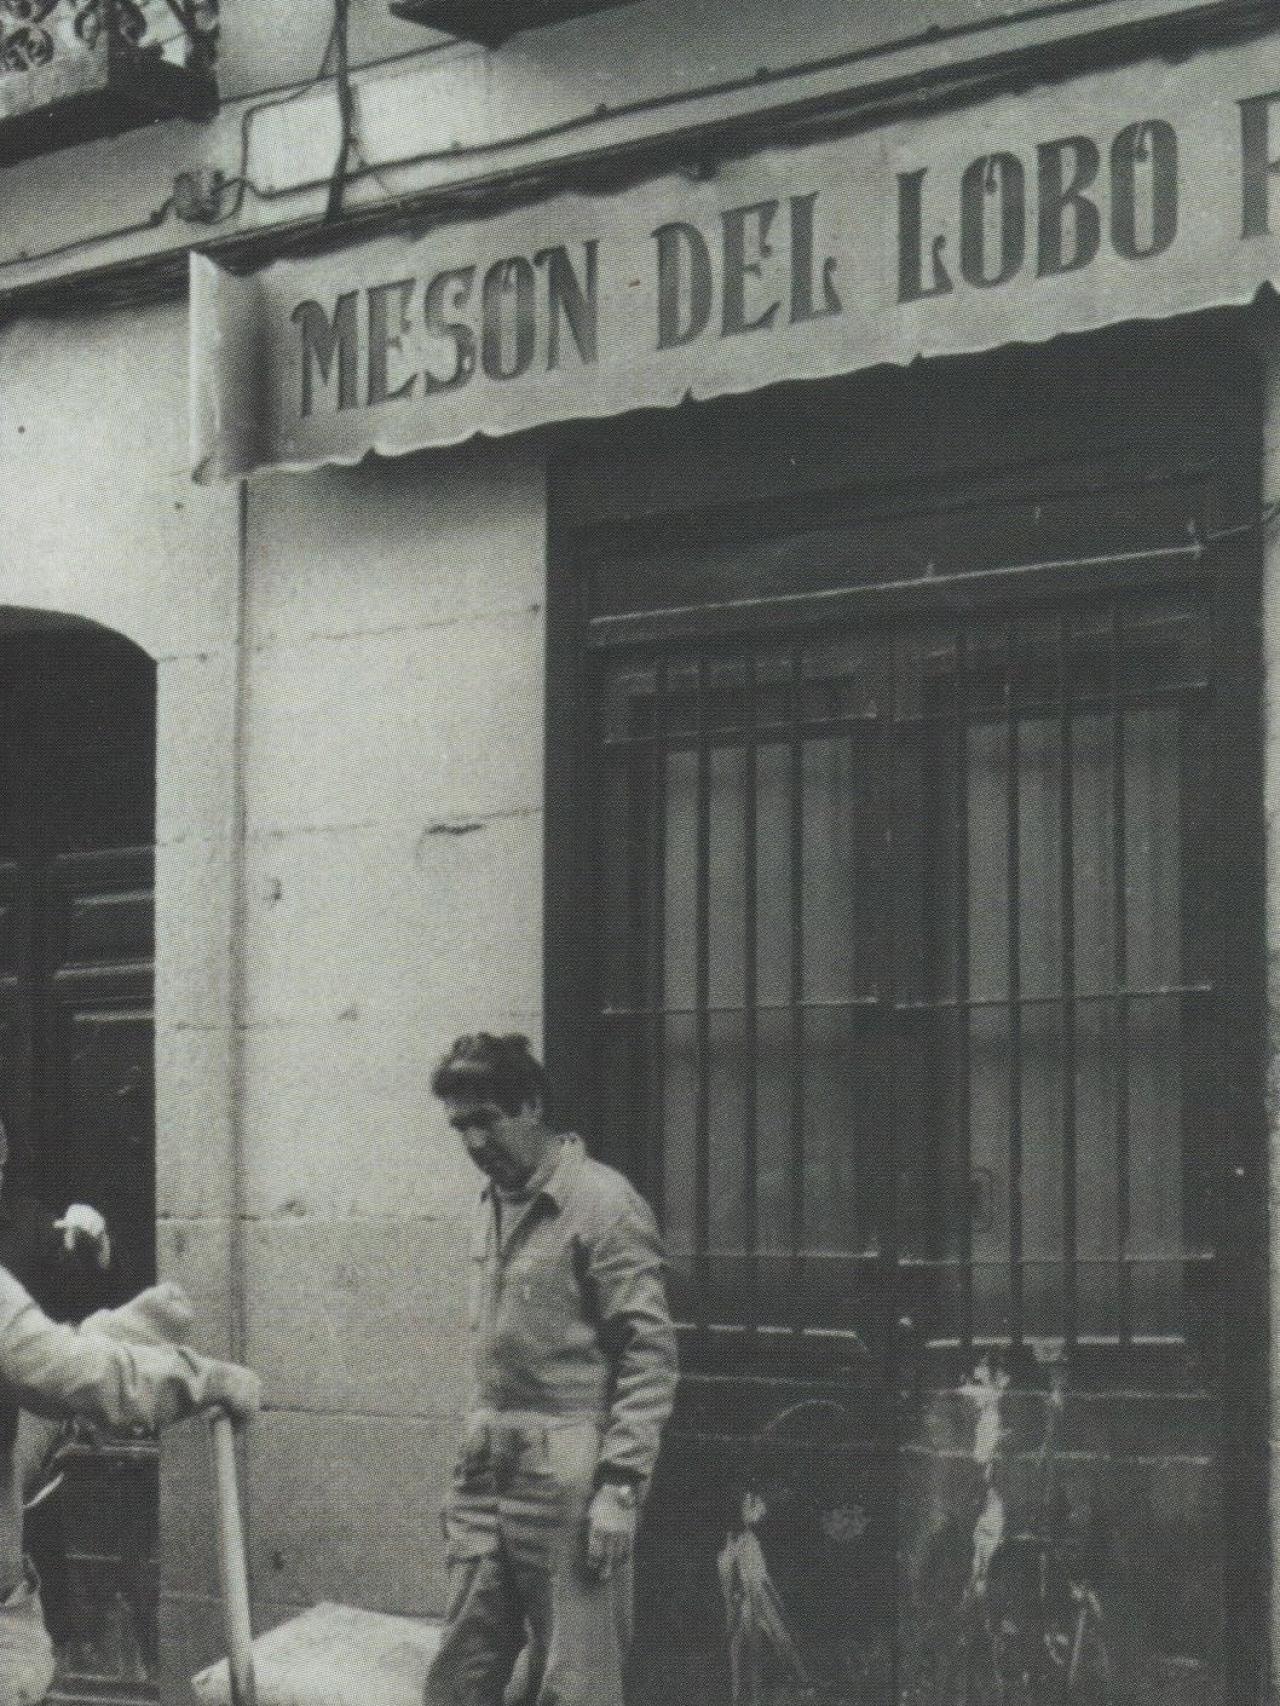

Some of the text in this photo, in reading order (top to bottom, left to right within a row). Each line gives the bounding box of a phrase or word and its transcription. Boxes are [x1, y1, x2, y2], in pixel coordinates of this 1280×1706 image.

[291, 239, 599, 418] MESON
[652, 190, 843, 350] DEL
[896, 119, 1179, 304] LOBO
